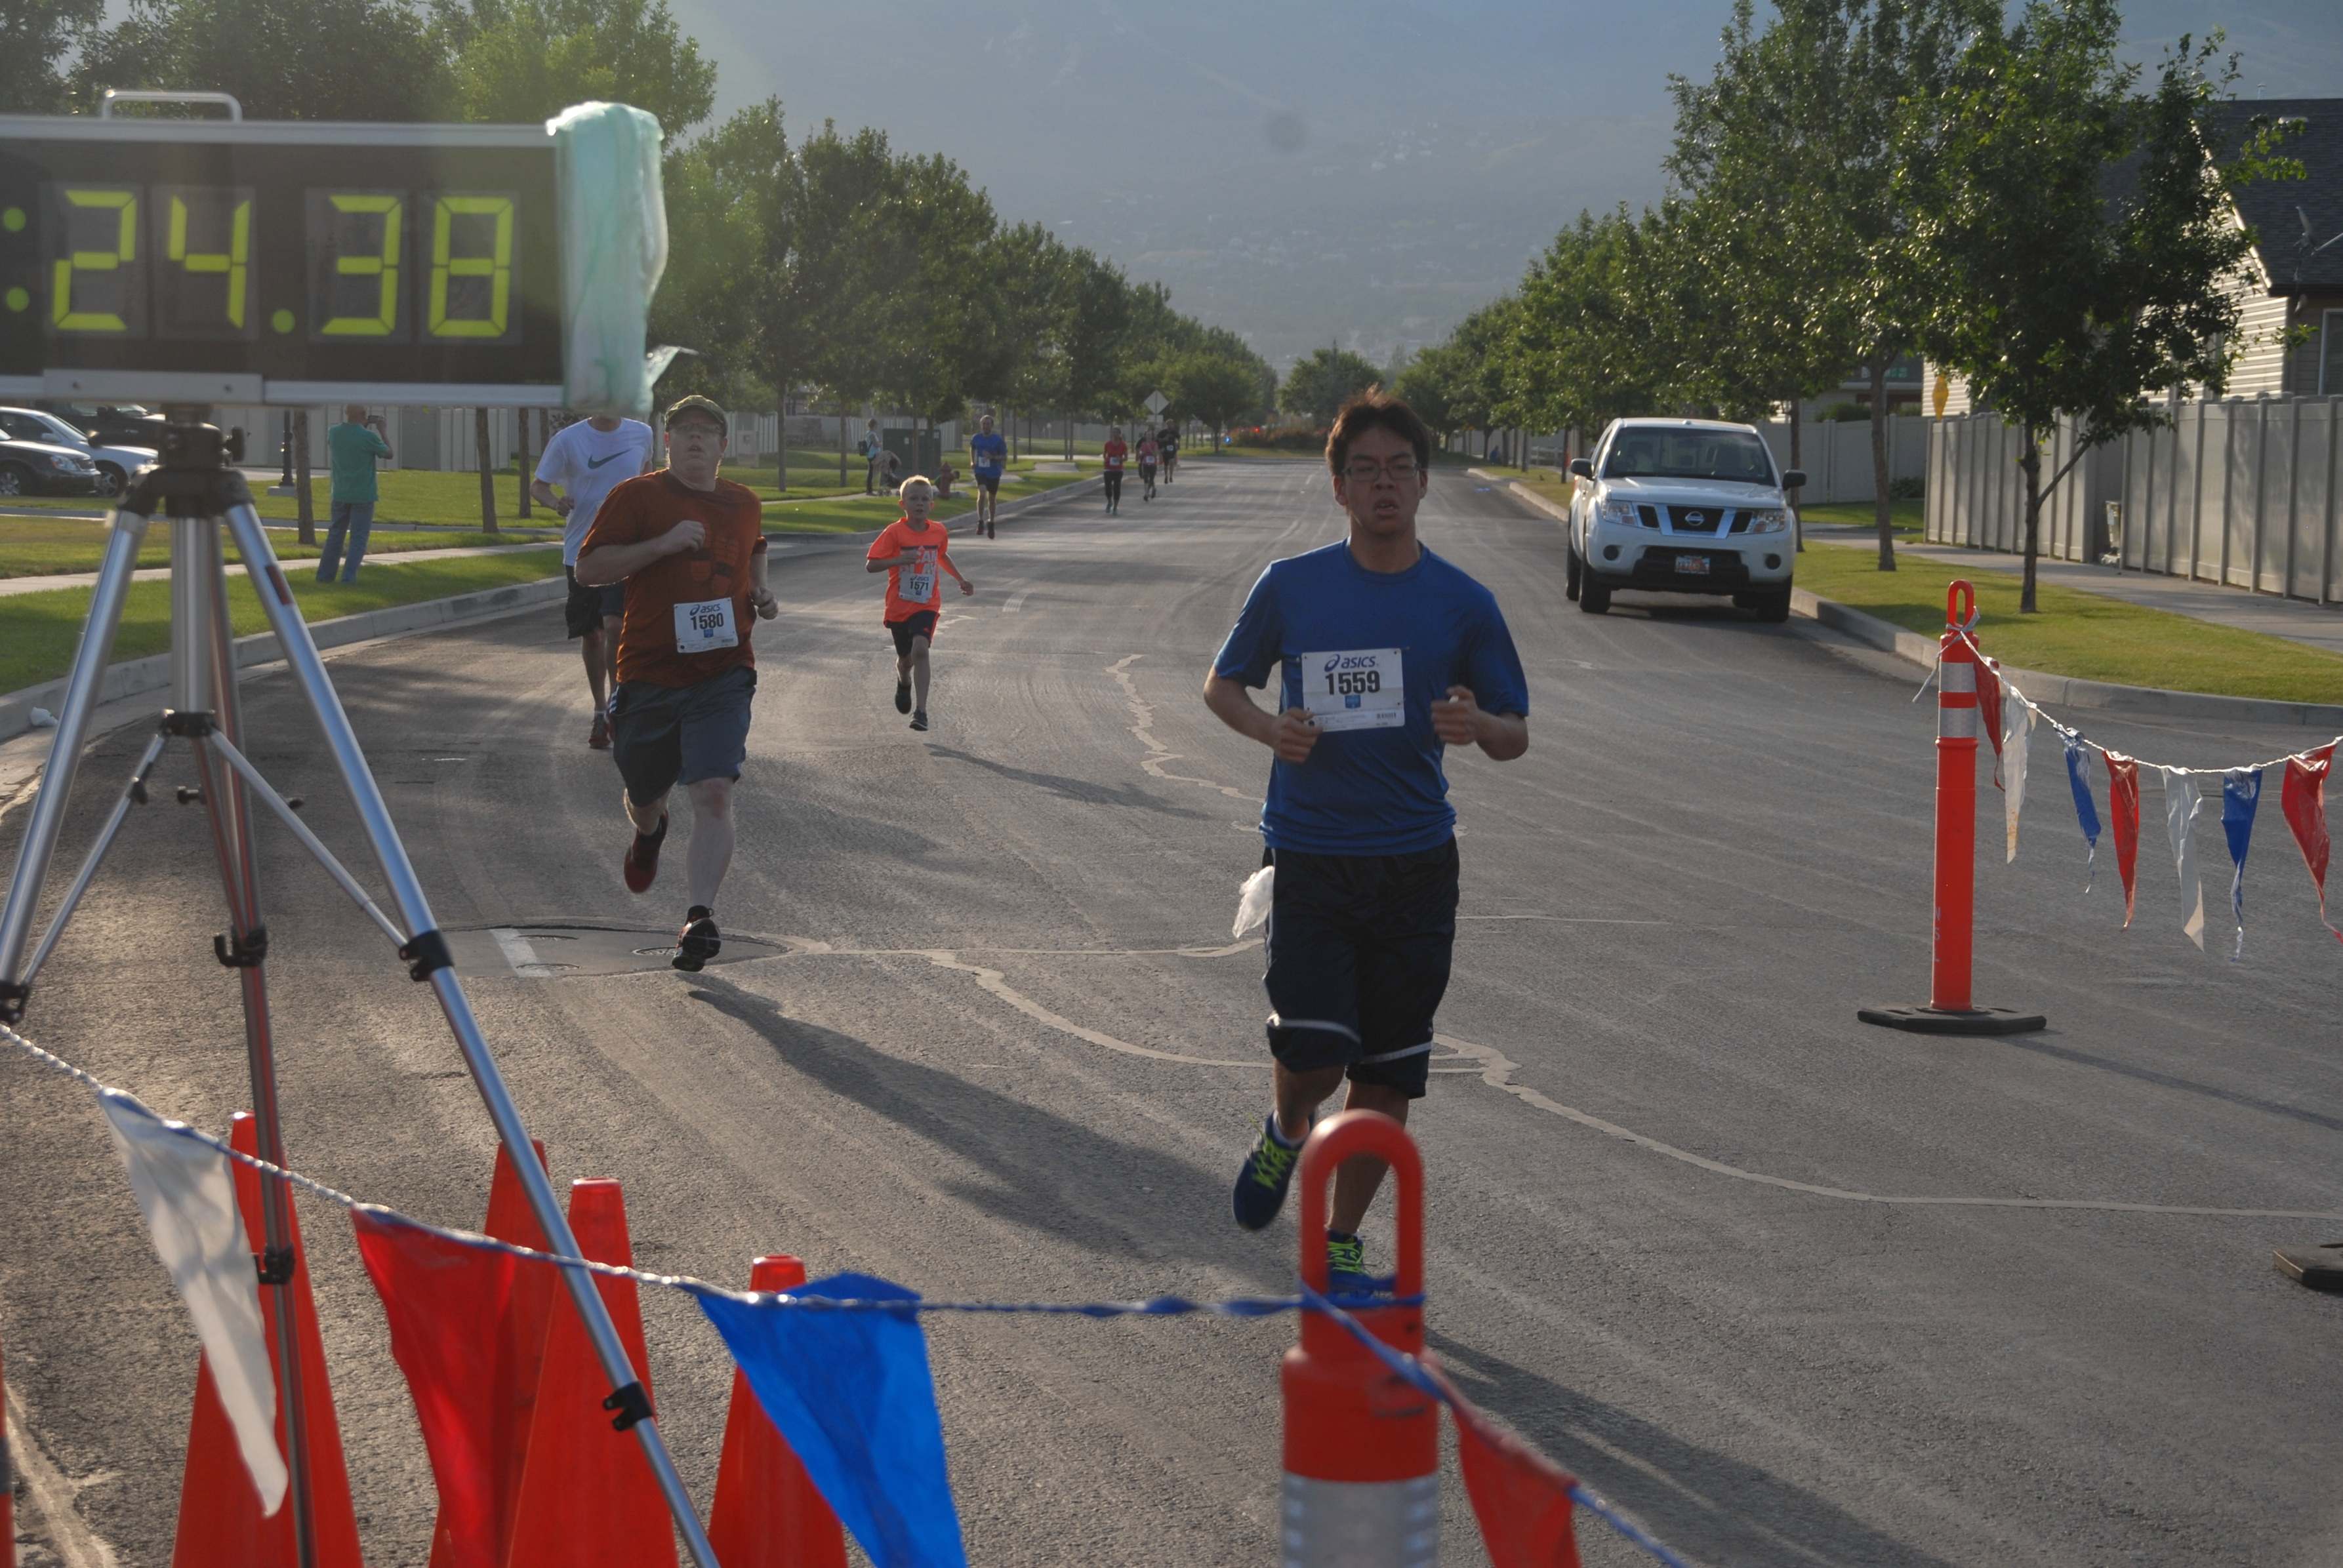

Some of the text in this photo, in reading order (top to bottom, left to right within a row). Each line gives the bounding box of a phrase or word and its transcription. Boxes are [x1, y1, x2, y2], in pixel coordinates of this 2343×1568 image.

[910, 581, 929, 591] 1571
[690, 613, 724, 630] 1580
[1341, 656, 1377, 669] asics
[1325, 670, 1381, 695] 1559
